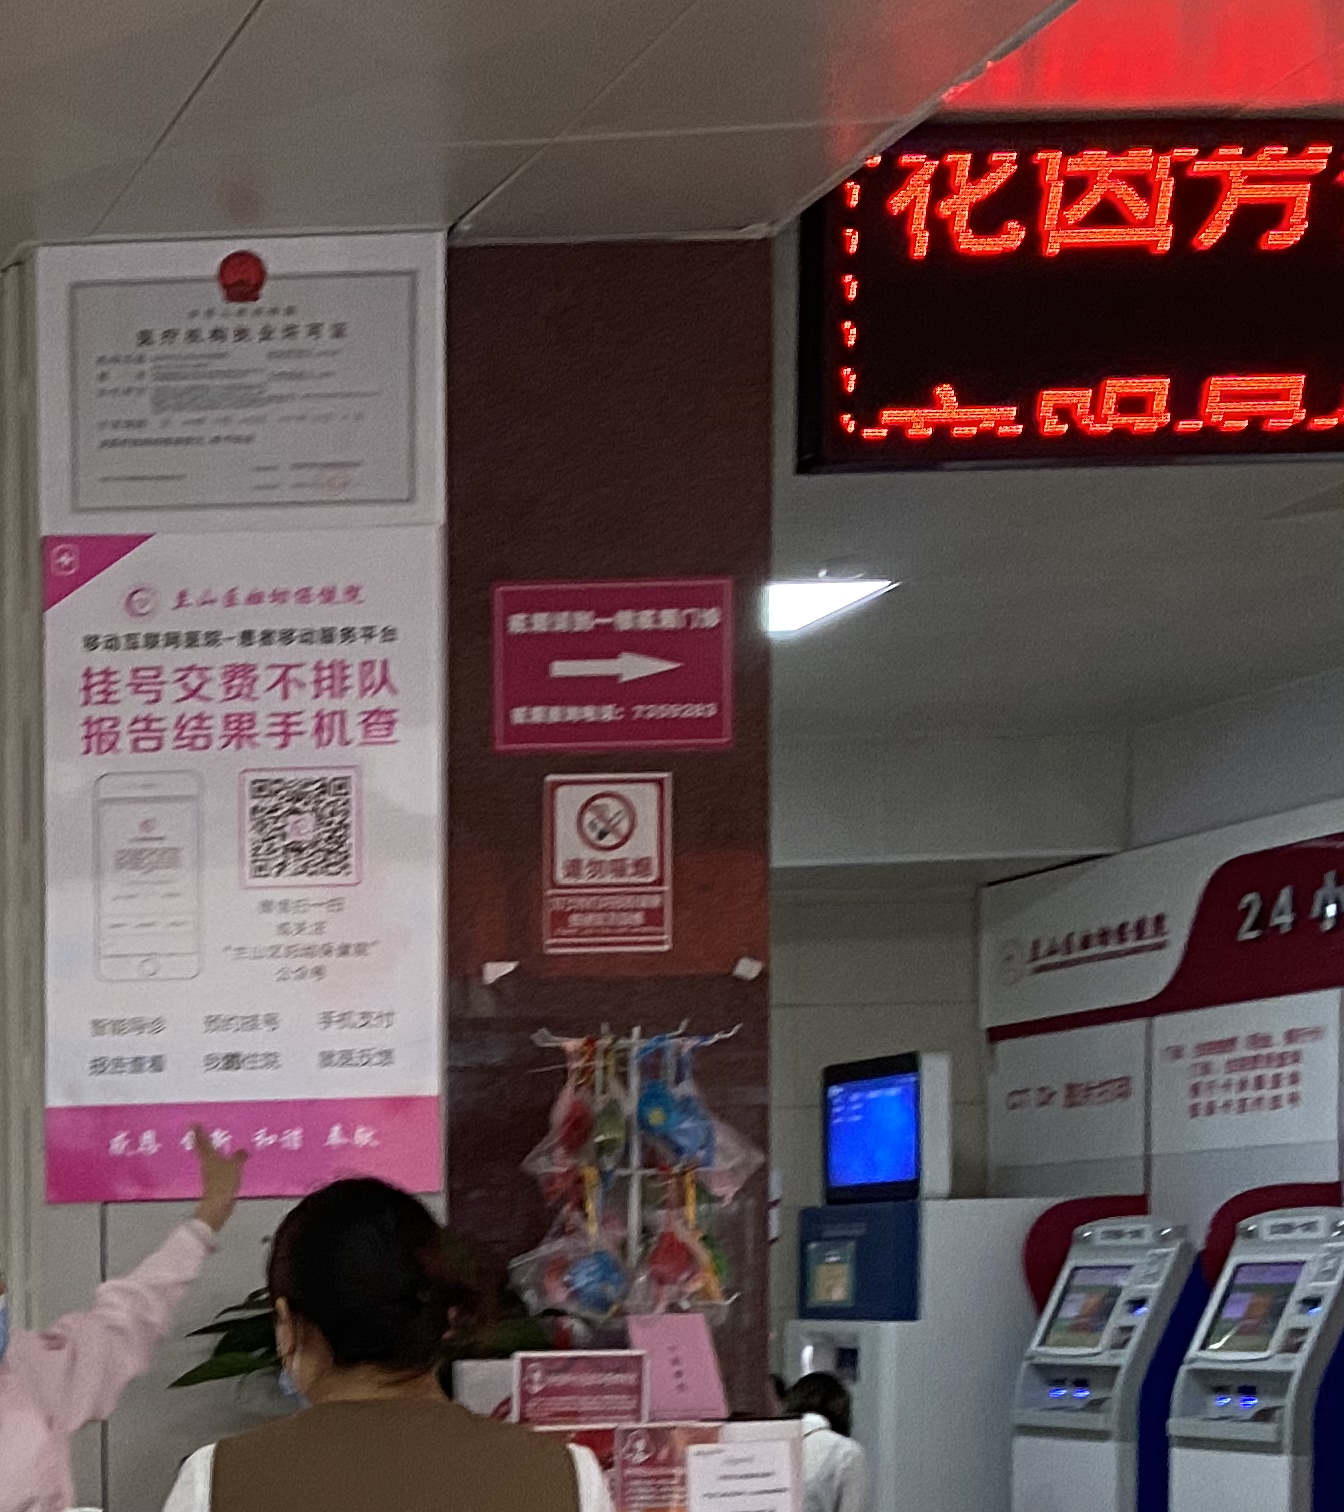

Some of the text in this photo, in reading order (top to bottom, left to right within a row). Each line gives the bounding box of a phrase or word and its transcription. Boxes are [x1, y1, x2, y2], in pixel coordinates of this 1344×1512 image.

[79, 657, 399, 707] 挂号交费不排队
[79, 705, 401, 756] 报告结果手机查
